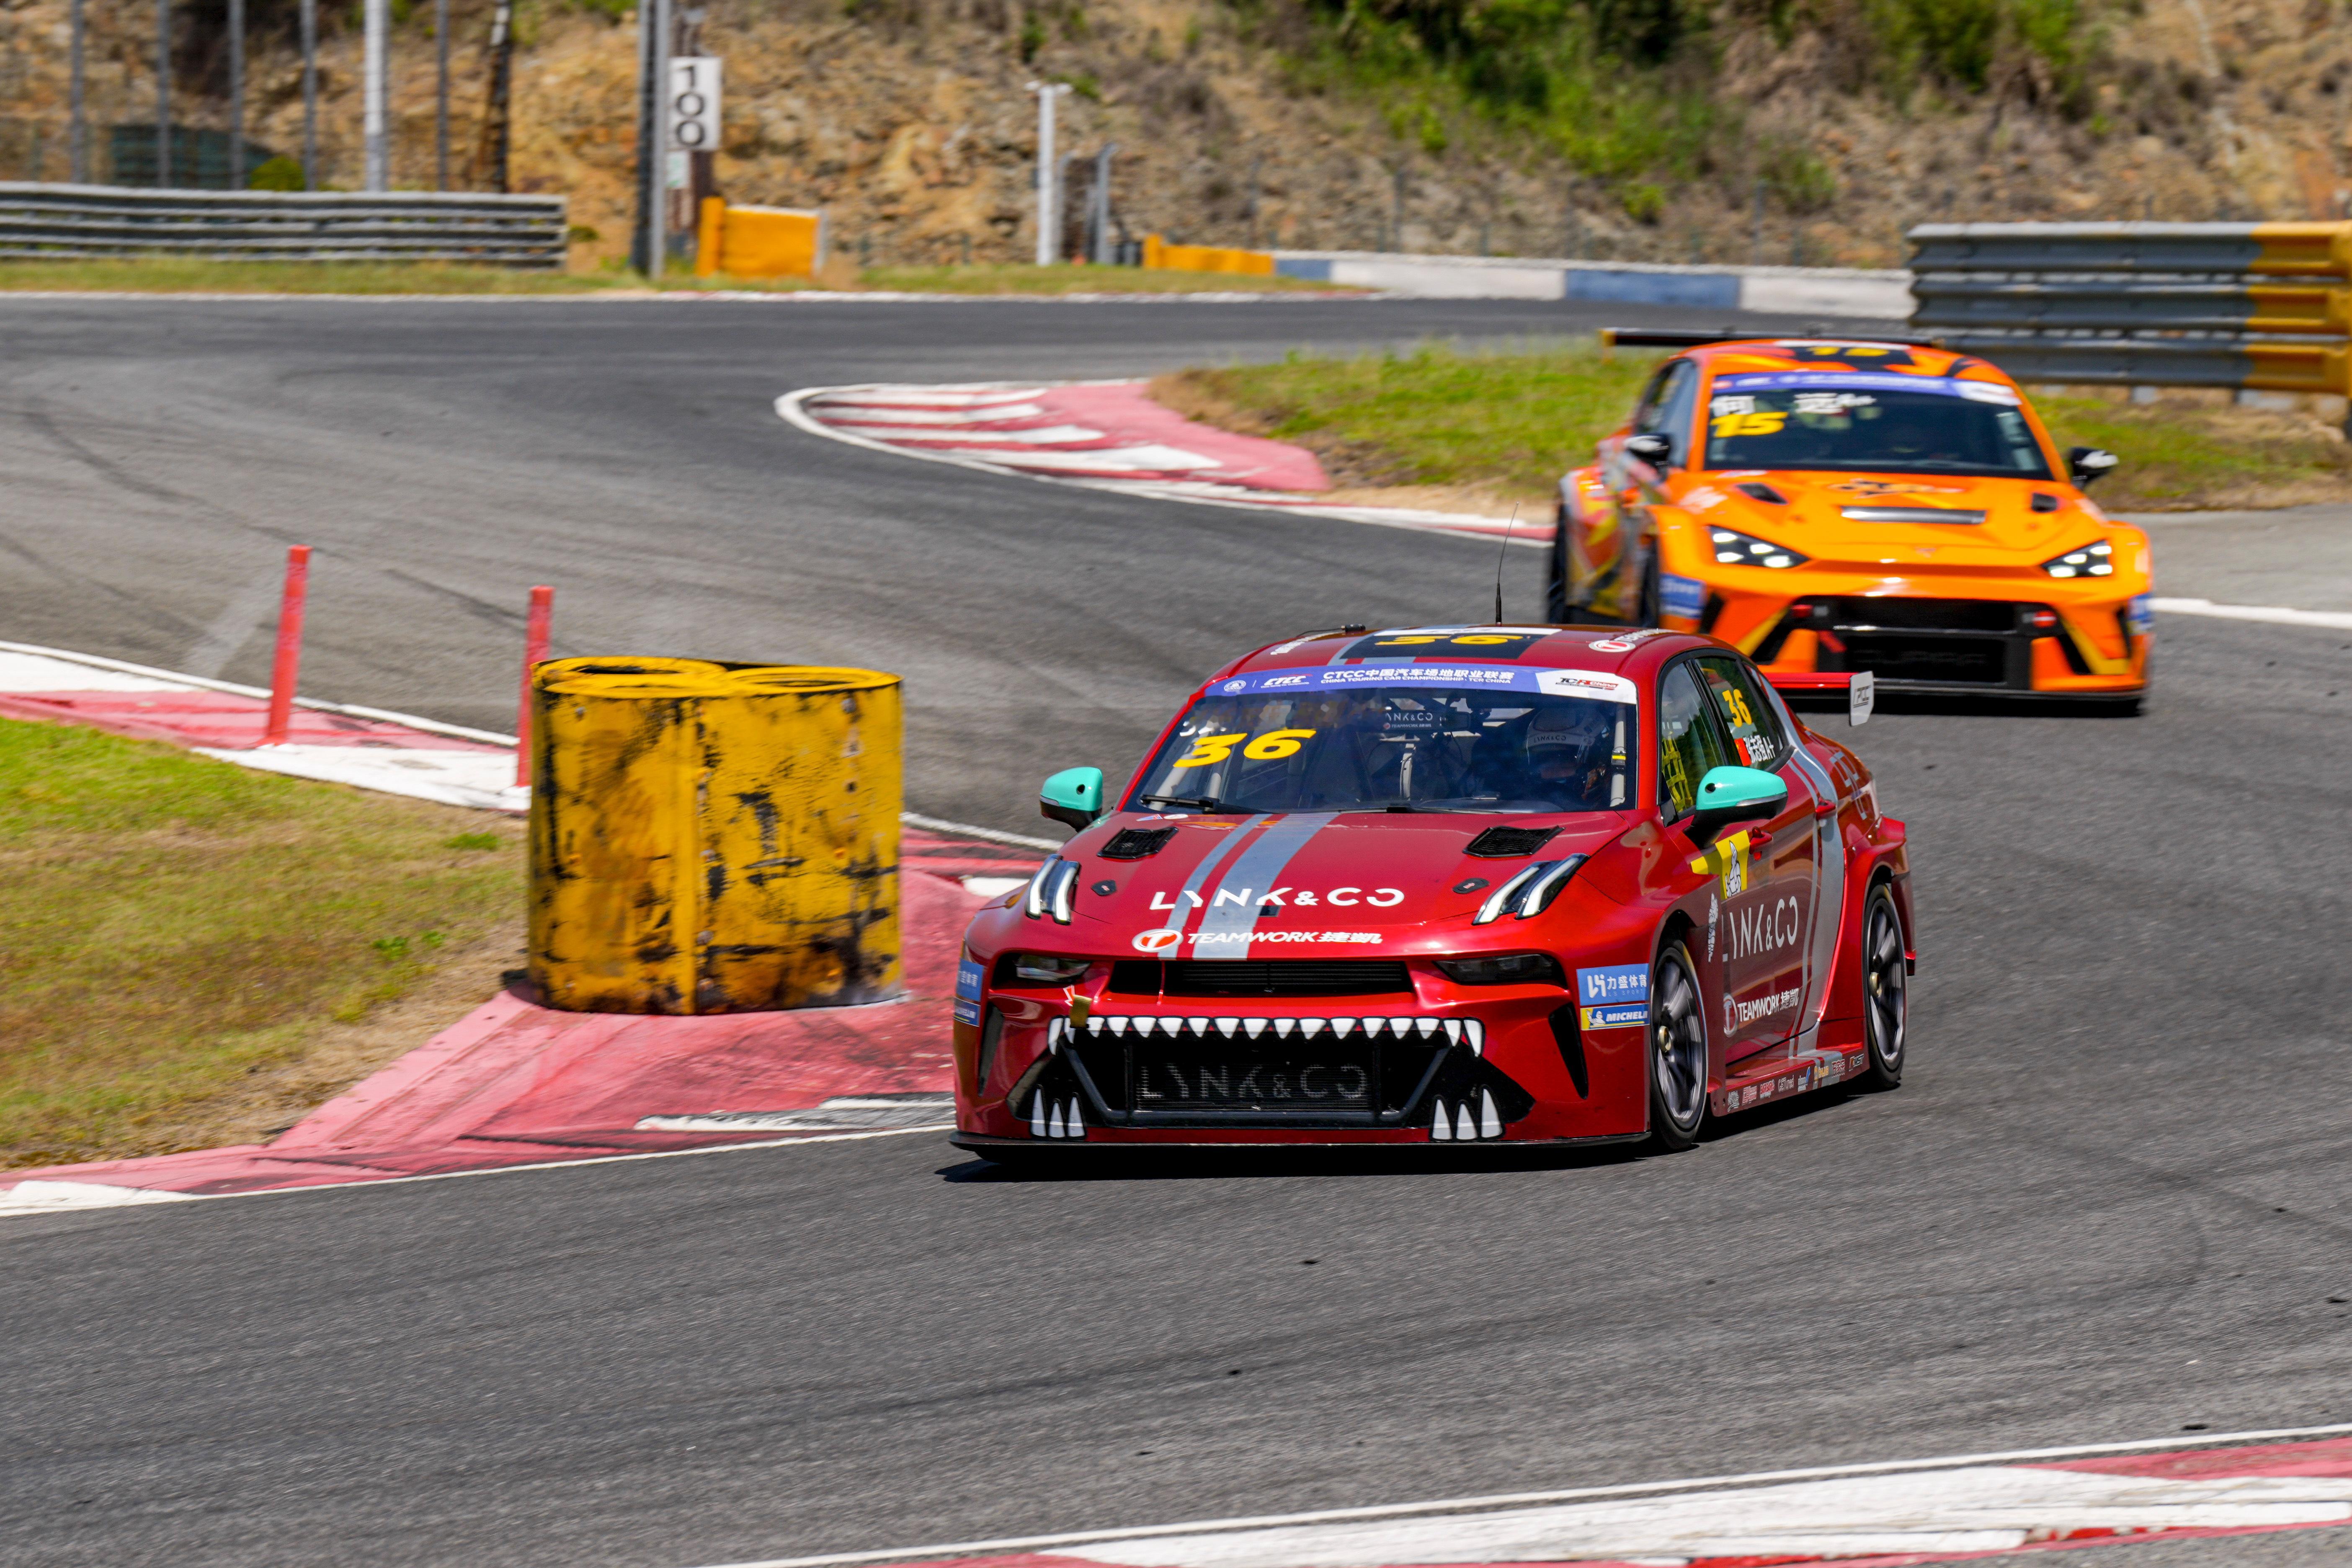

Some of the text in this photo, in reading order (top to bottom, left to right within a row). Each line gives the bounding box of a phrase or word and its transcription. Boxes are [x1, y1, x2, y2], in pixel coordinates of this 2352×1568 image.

[673, 65, 705, 146] 100
[1710, 412, 1789, 438] 15
[1375, 635, 1523, 645] 36
[1722, 689, 1752, 728] 36
[1173, 729, 1316, 767] 36
[1187, 931, 1319, 944] TEAMWORK
[1607, 974, 1647, 990] 力盛体育
[1738, 993, 1780, 1022] TEAMWORK
